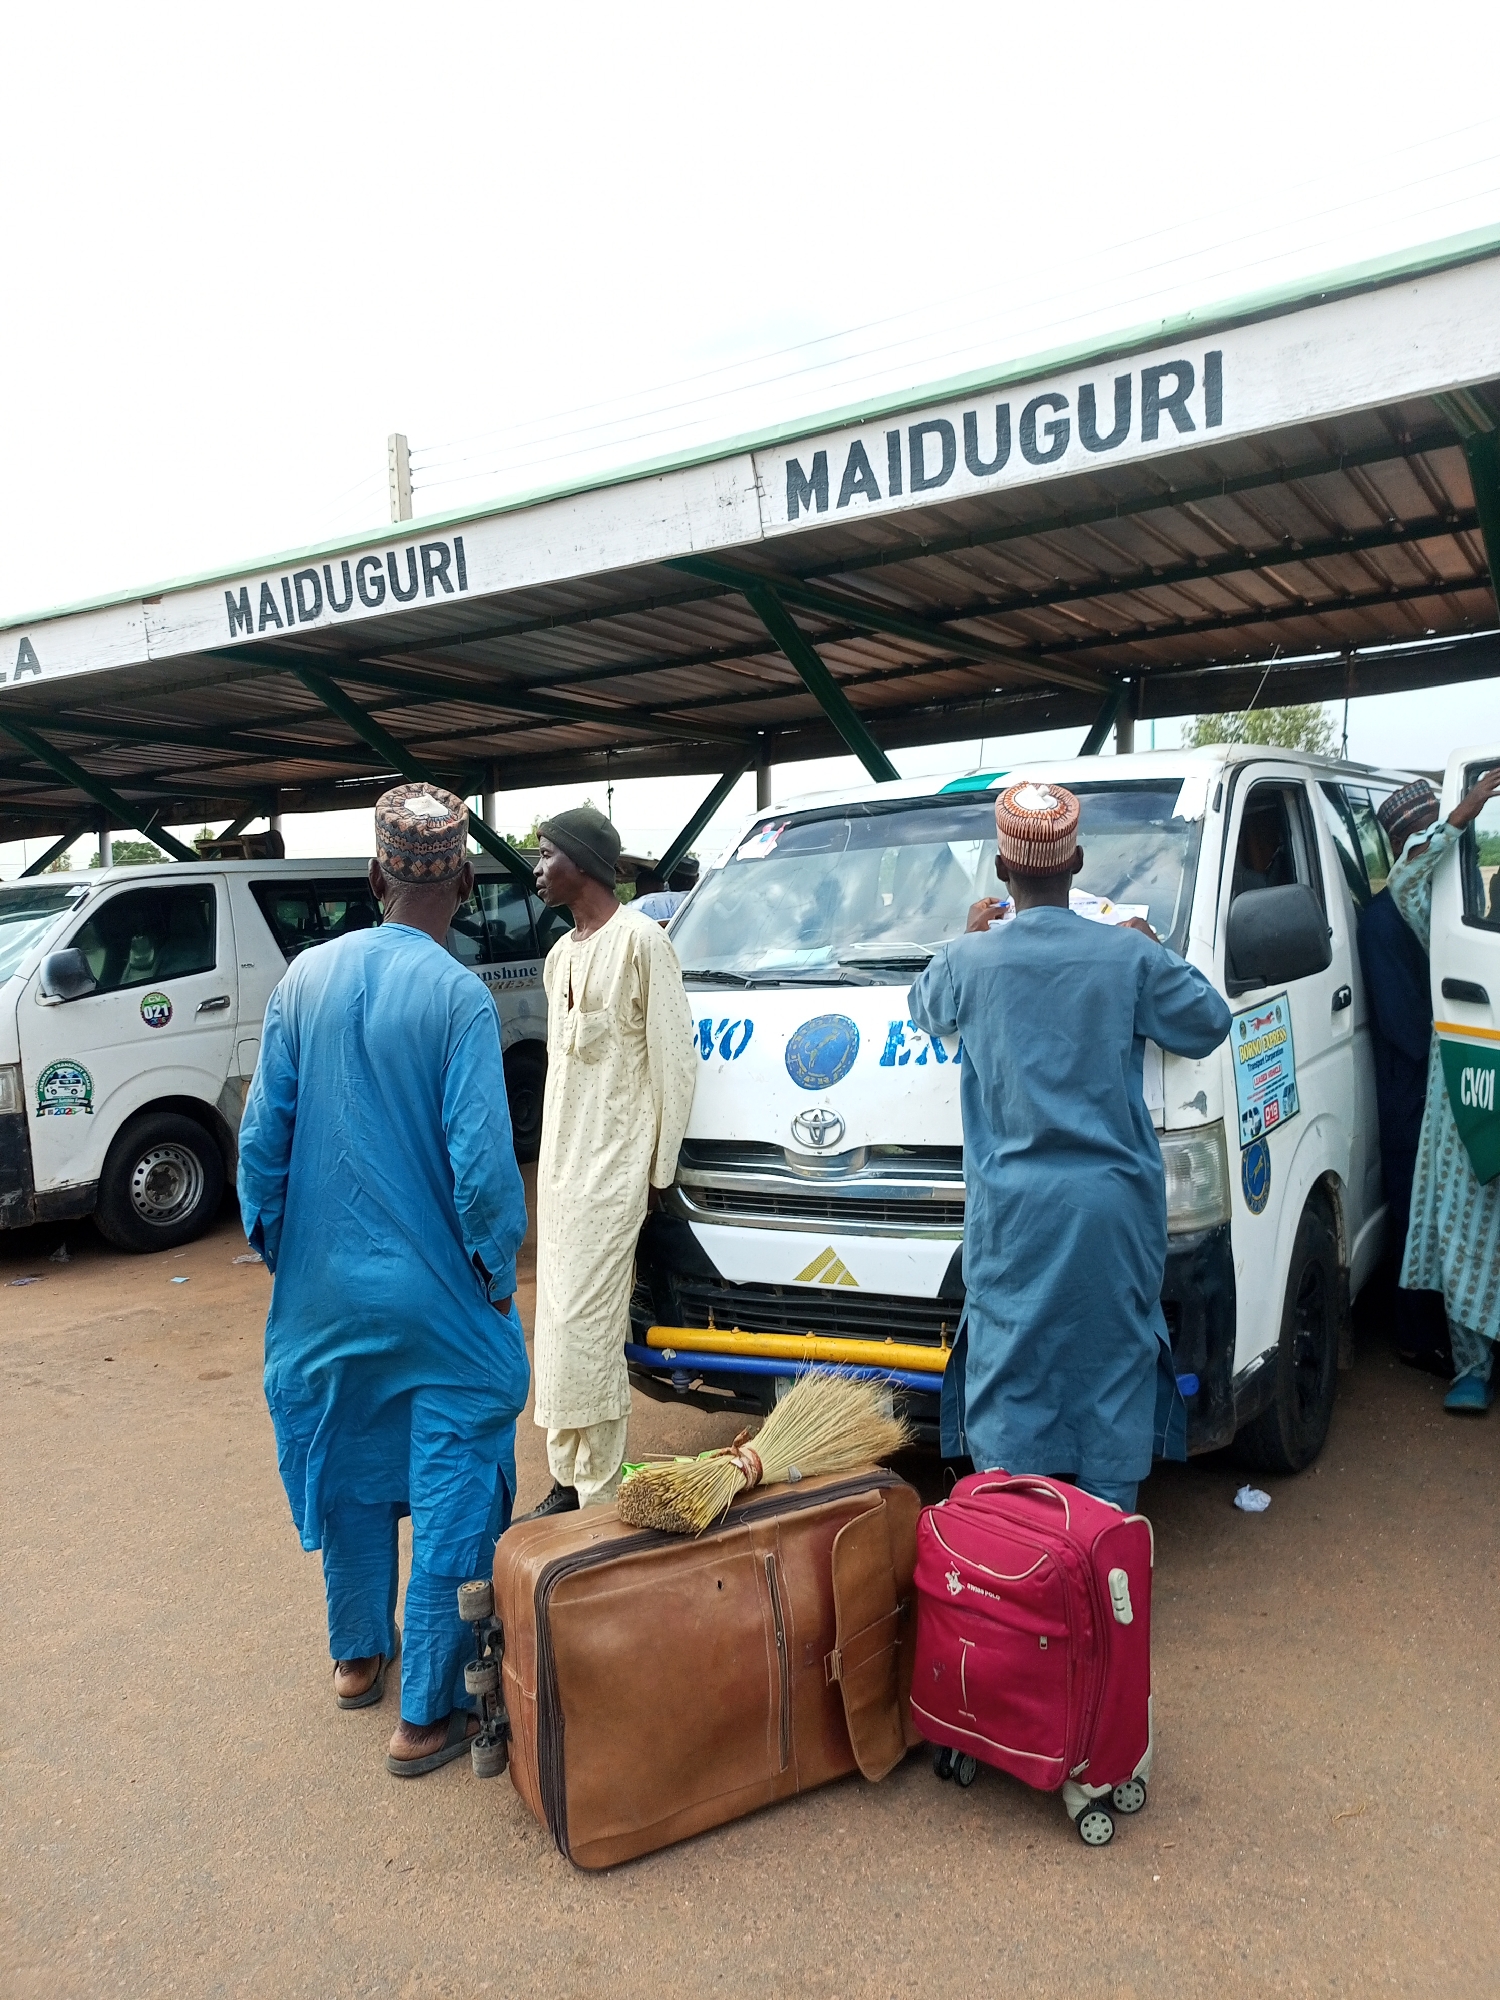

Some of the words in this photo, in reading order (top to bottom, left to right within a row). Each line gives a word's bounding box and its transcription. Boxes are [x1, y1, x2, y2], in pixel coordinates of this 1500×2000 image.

[785, 350, 1223, 522] MAIDUGURI
[225, 536, 468, 638] MAIDUGURI
[144, 1003, 169, 1019] 021
[1238, 1037, 1262, 1065] BORNO
[1261, 1025, 1288, 1053] EXPRESS
